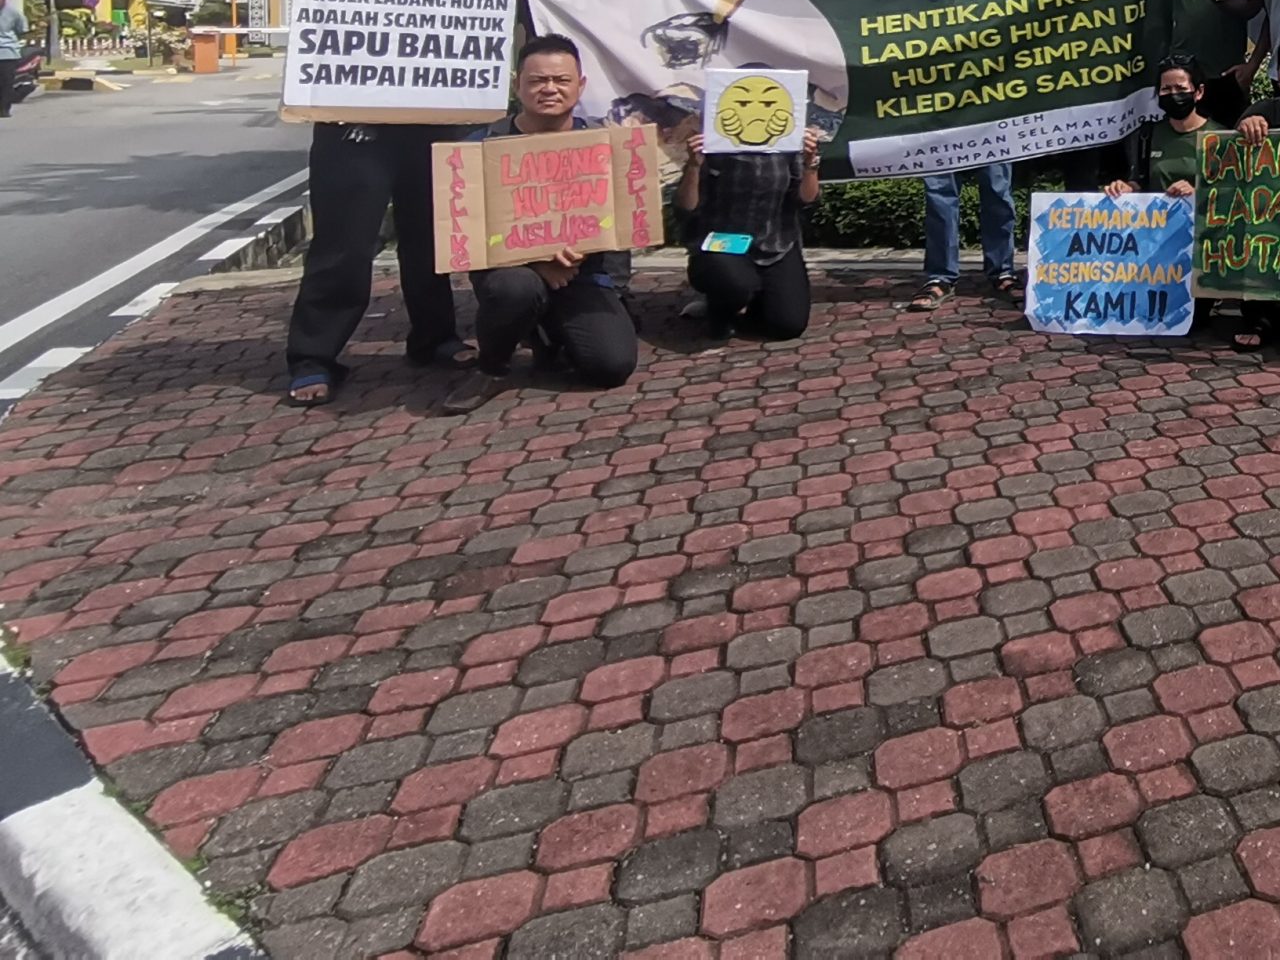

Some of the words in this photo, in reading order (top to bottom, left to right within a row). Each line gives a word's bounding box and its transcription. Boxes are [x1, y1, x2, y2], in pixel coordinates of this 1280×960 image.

[297, 8, 378, 26] ADALAH
[383, 12, 436, 29] SCAM
[441, 16, 504, 33] UNTUK
[861, 28, 1001, 65] LADANG
[1010, 7, 1116, 44] HUTAN
[1124, 0, 1146, 25] DI
[298, 28, 390, 58] SAPU
[397, 33, 506, 61] BALAK
[892, 57, 1005, 89] HUTAN
[1014, 33, 1133, 68] SIMPAN
[299, 63, 406, 87] SAMPAI
[411, 66, 501, 89] HABIS!
[876, 79, 1028, 119] KLEDANG
[1036, 55, 1146, 93] SAIONG
[903, 134, 1006, 158] JARINGAN
[1018, 107, 1135, 139] SELAMATKAN
[998, 114, 1045, 129] OLEH
[936, 148, 1010, 167] SIMPAN
[1022, 131, 1108, 152] KLEDANG
[1119, 114, 1166, 136] SAION
[501, 143, 612, 186] LADANG
[512, 178, 608, 219] HUTAN
[1048, 206, 1168, 230] KETAMAKAN
[1067, 232, 1139, 257] ANDA
[1036, 261, 1183, 285] KESENGSARAAN
[1064, 290, 1136, 320] KAMI
